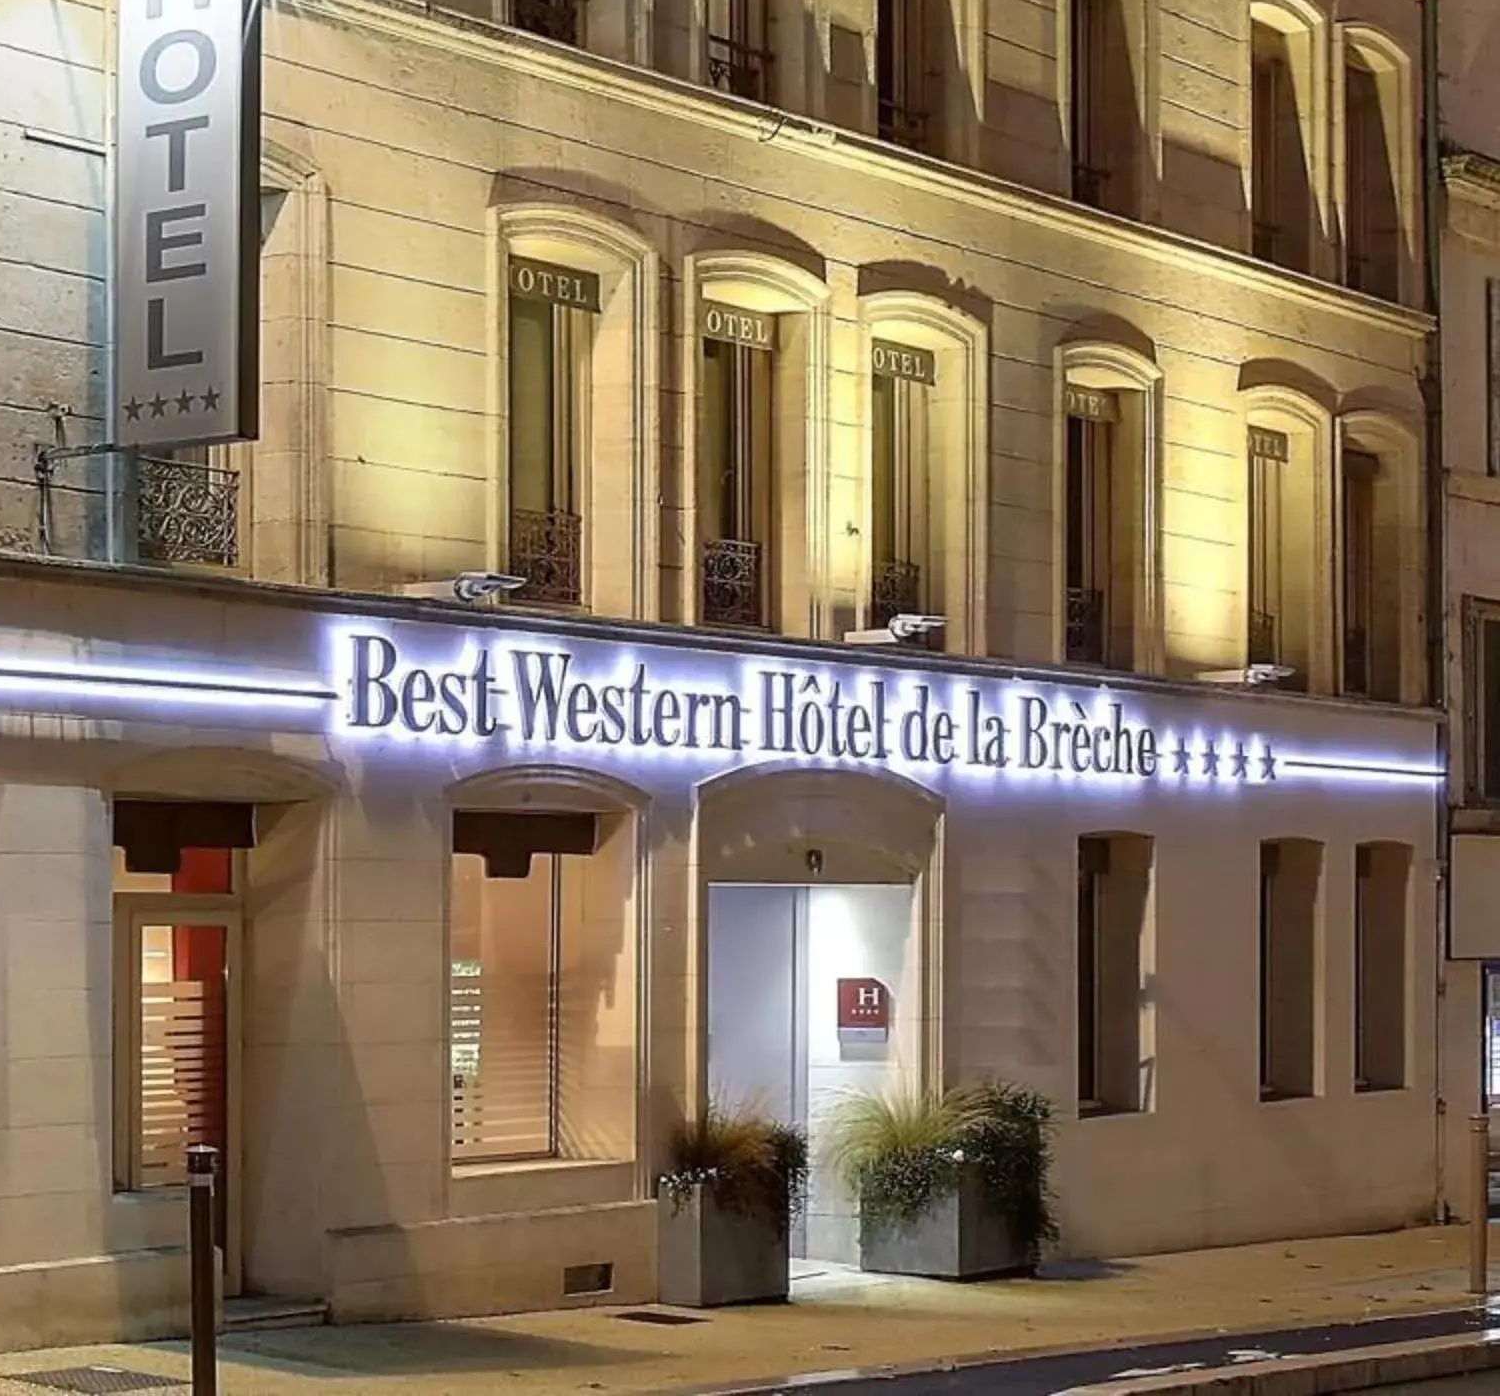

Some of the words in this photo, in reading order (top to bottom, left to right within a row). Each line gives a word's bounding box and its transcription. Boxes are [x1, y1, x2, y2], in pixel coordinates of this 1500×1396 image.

[707, 308, 767, 343] OTEL
[873, 347, 924, 378] OTEL
[347, 634, 498, 737] Best
[508, 649, 744, 752] Western
[758, 669, 889, 761] Hôtel
[901, 684, 957, 766] de
[966, 690, 1011, 769] la
[1016, 695, 1157, 778] Brèche
[858, 987, 880, 1006] H
